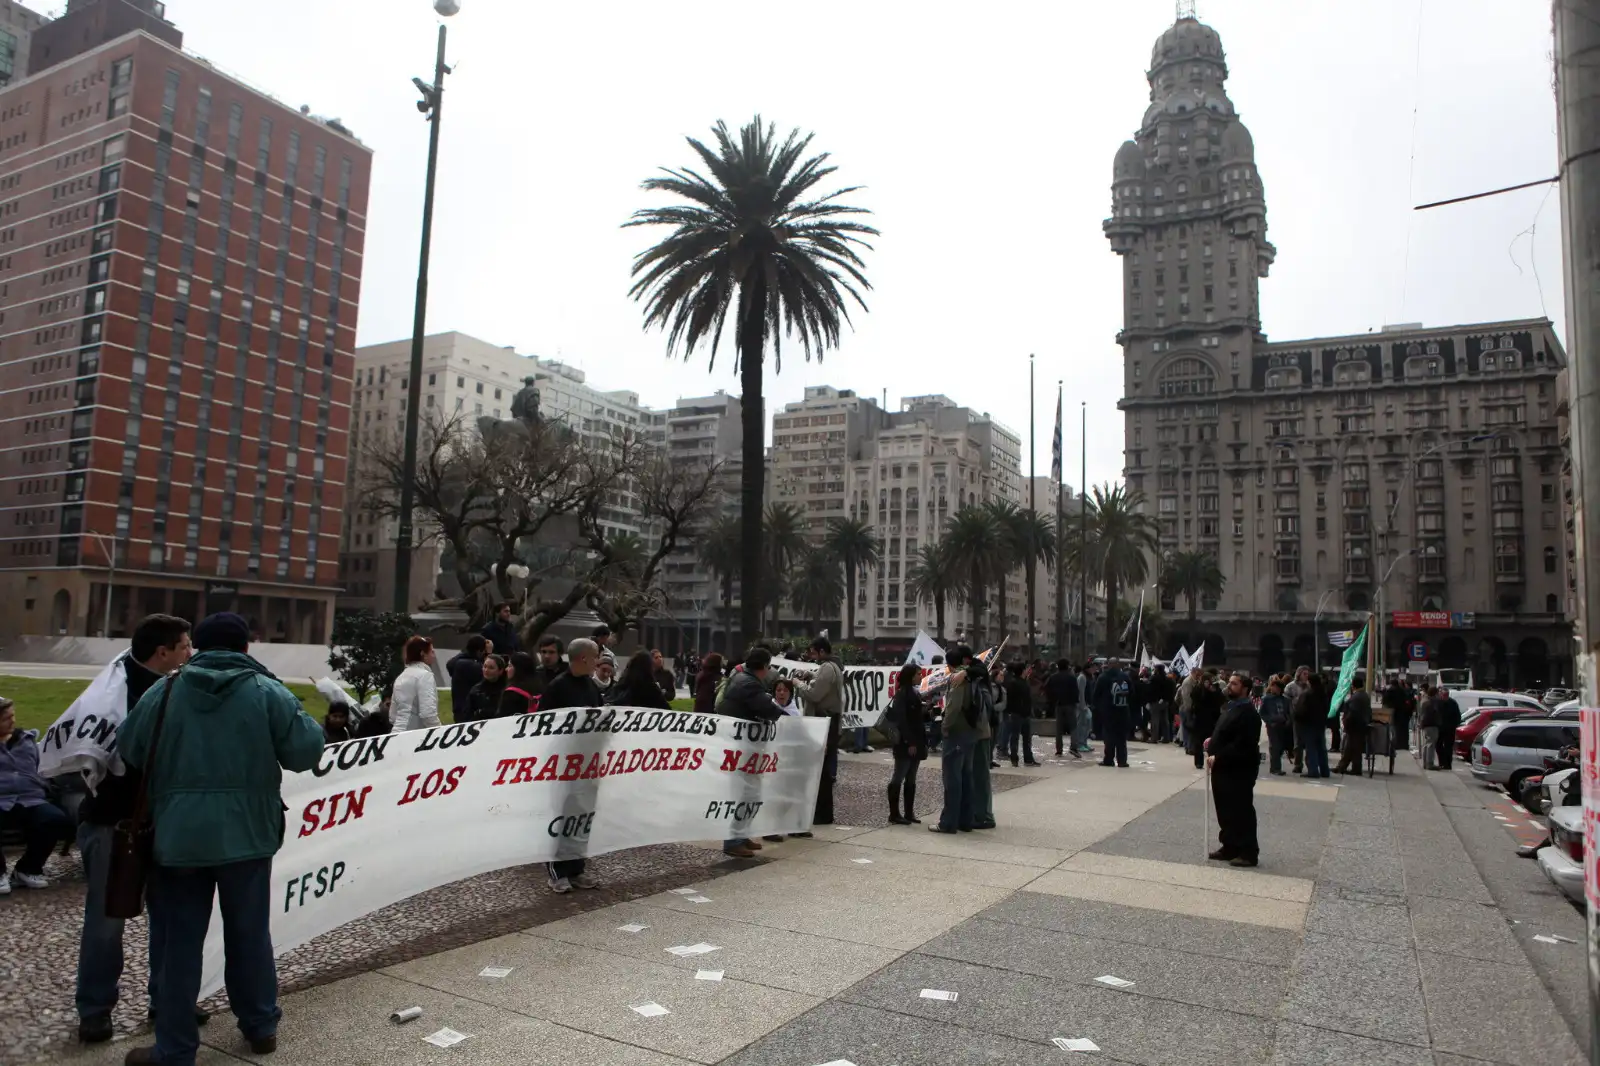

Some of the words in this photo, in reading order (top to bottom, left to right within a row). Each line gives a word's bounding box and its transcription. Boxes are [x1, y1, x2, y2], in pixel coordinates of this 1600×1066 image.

[1420, 612, 1448, 620] VENDO
[1413, 644, 1425, 657] E
[43, 719, 75, 753] PIT
[312, 734, 399, 777] CON
[414, 720, 489, 753] LOS
[512, 709, 720, 738] TRABAJADORES
[298, 785, 373, 838] SIN
[397, 765, 467, 805] LOS
[491, 747, 706, 786] TRABAJADORES
[720, 749, 779, 774] NADA
[284, 861, 346, 913] FFSP
